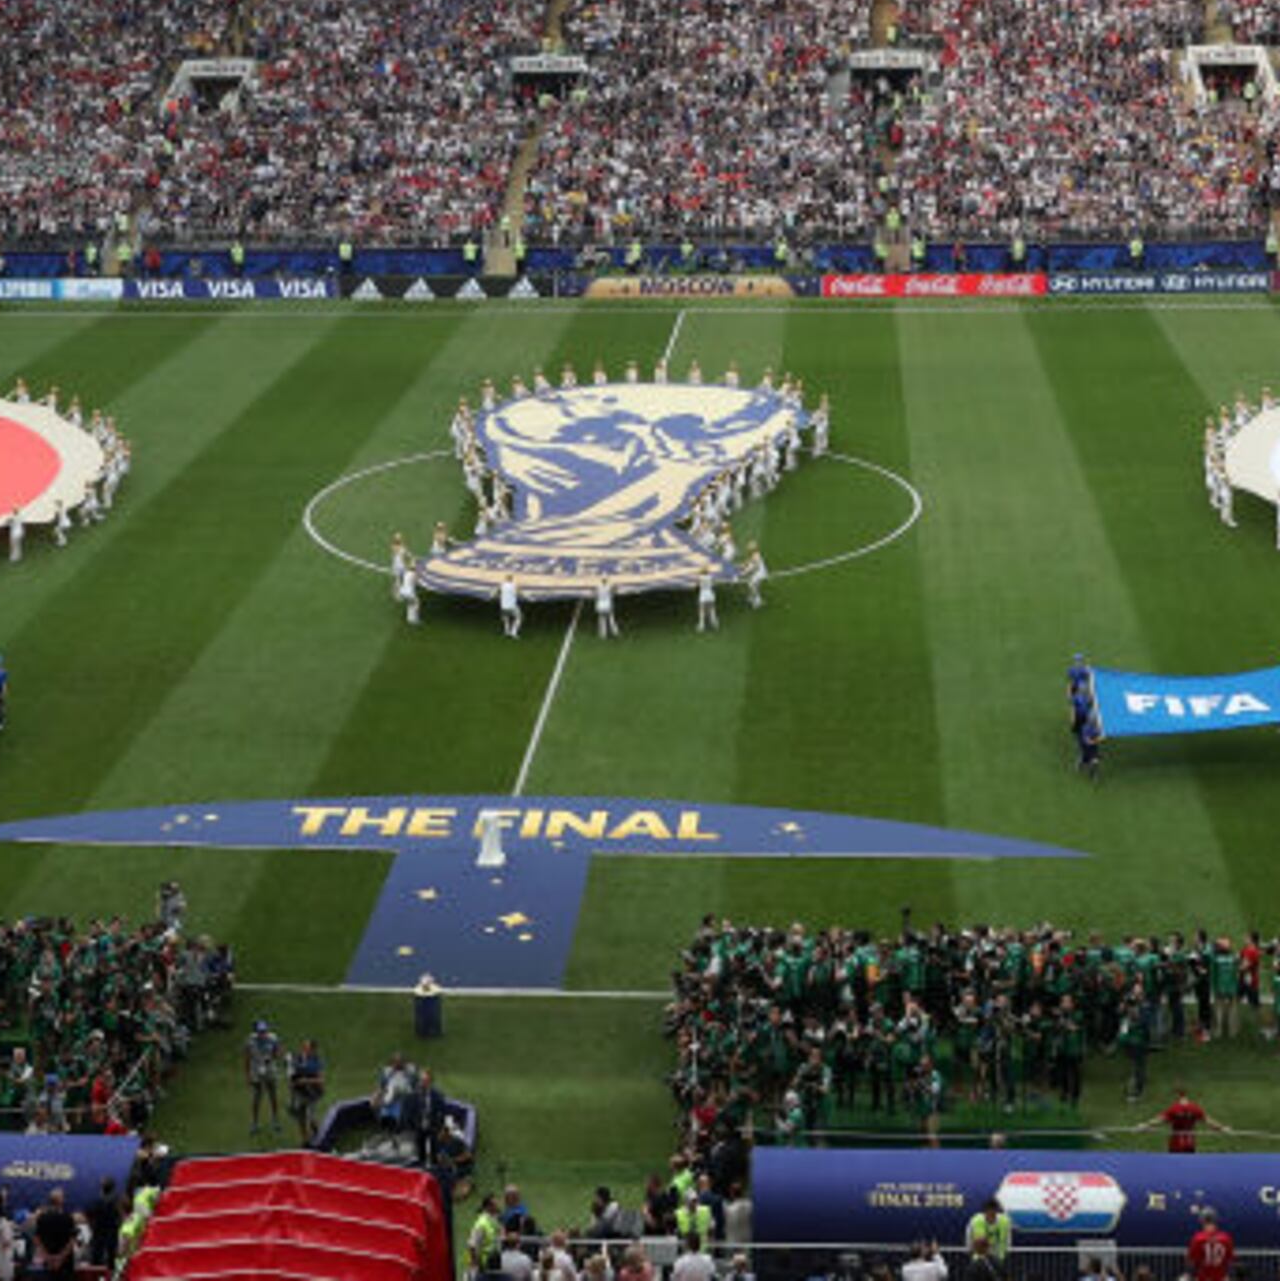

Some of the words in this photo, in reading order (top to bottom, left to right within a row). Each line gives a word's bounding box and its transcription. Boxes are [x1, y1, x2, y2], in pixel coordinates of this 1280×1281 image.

[137, 280, 184, 298] VISA
[207, 280, 255, 298] VISA
[278, 280, 327, 298] VISA
[639, 276, 735, 295] MOSCOW
[1082, 276, 1155, 289] HYUNDAI
[1194, 274, 1268, 288] HYUNDAI
[1124, 691, 1271, 716] FIFA
[292, 806, 458, 837] THE
